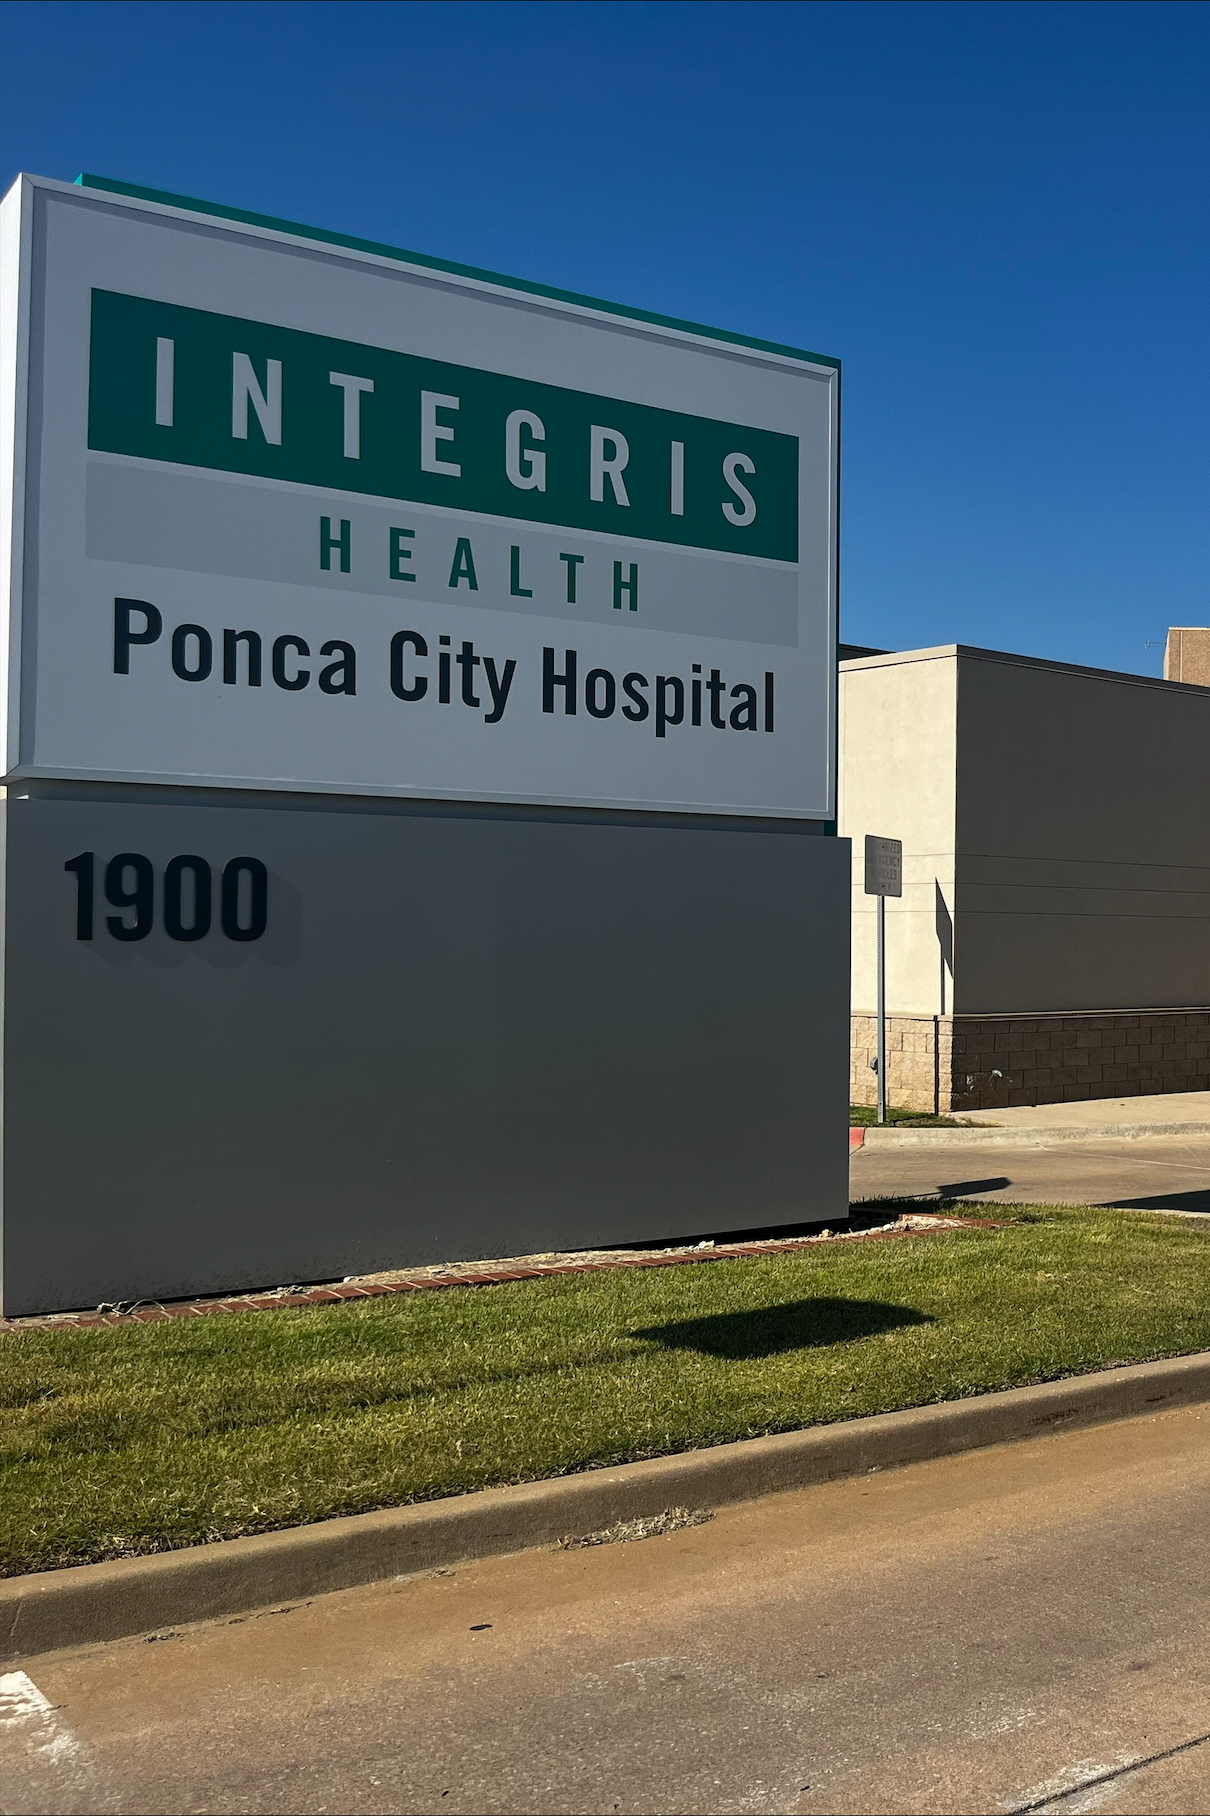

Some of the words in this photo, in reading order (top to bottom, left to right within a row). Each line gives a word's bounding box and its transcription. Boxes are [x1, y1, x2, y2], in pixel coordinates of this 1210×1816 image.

[156, 337, 758, 527] INTEGRIS
[320, 515, 639, 612] HEALTH
[113, 597, 357, 696] Ponca
[390, 630, 518, 724] City
[542, 646, 776, 739] Hospital
[64, 851, 268, 942] 1900
